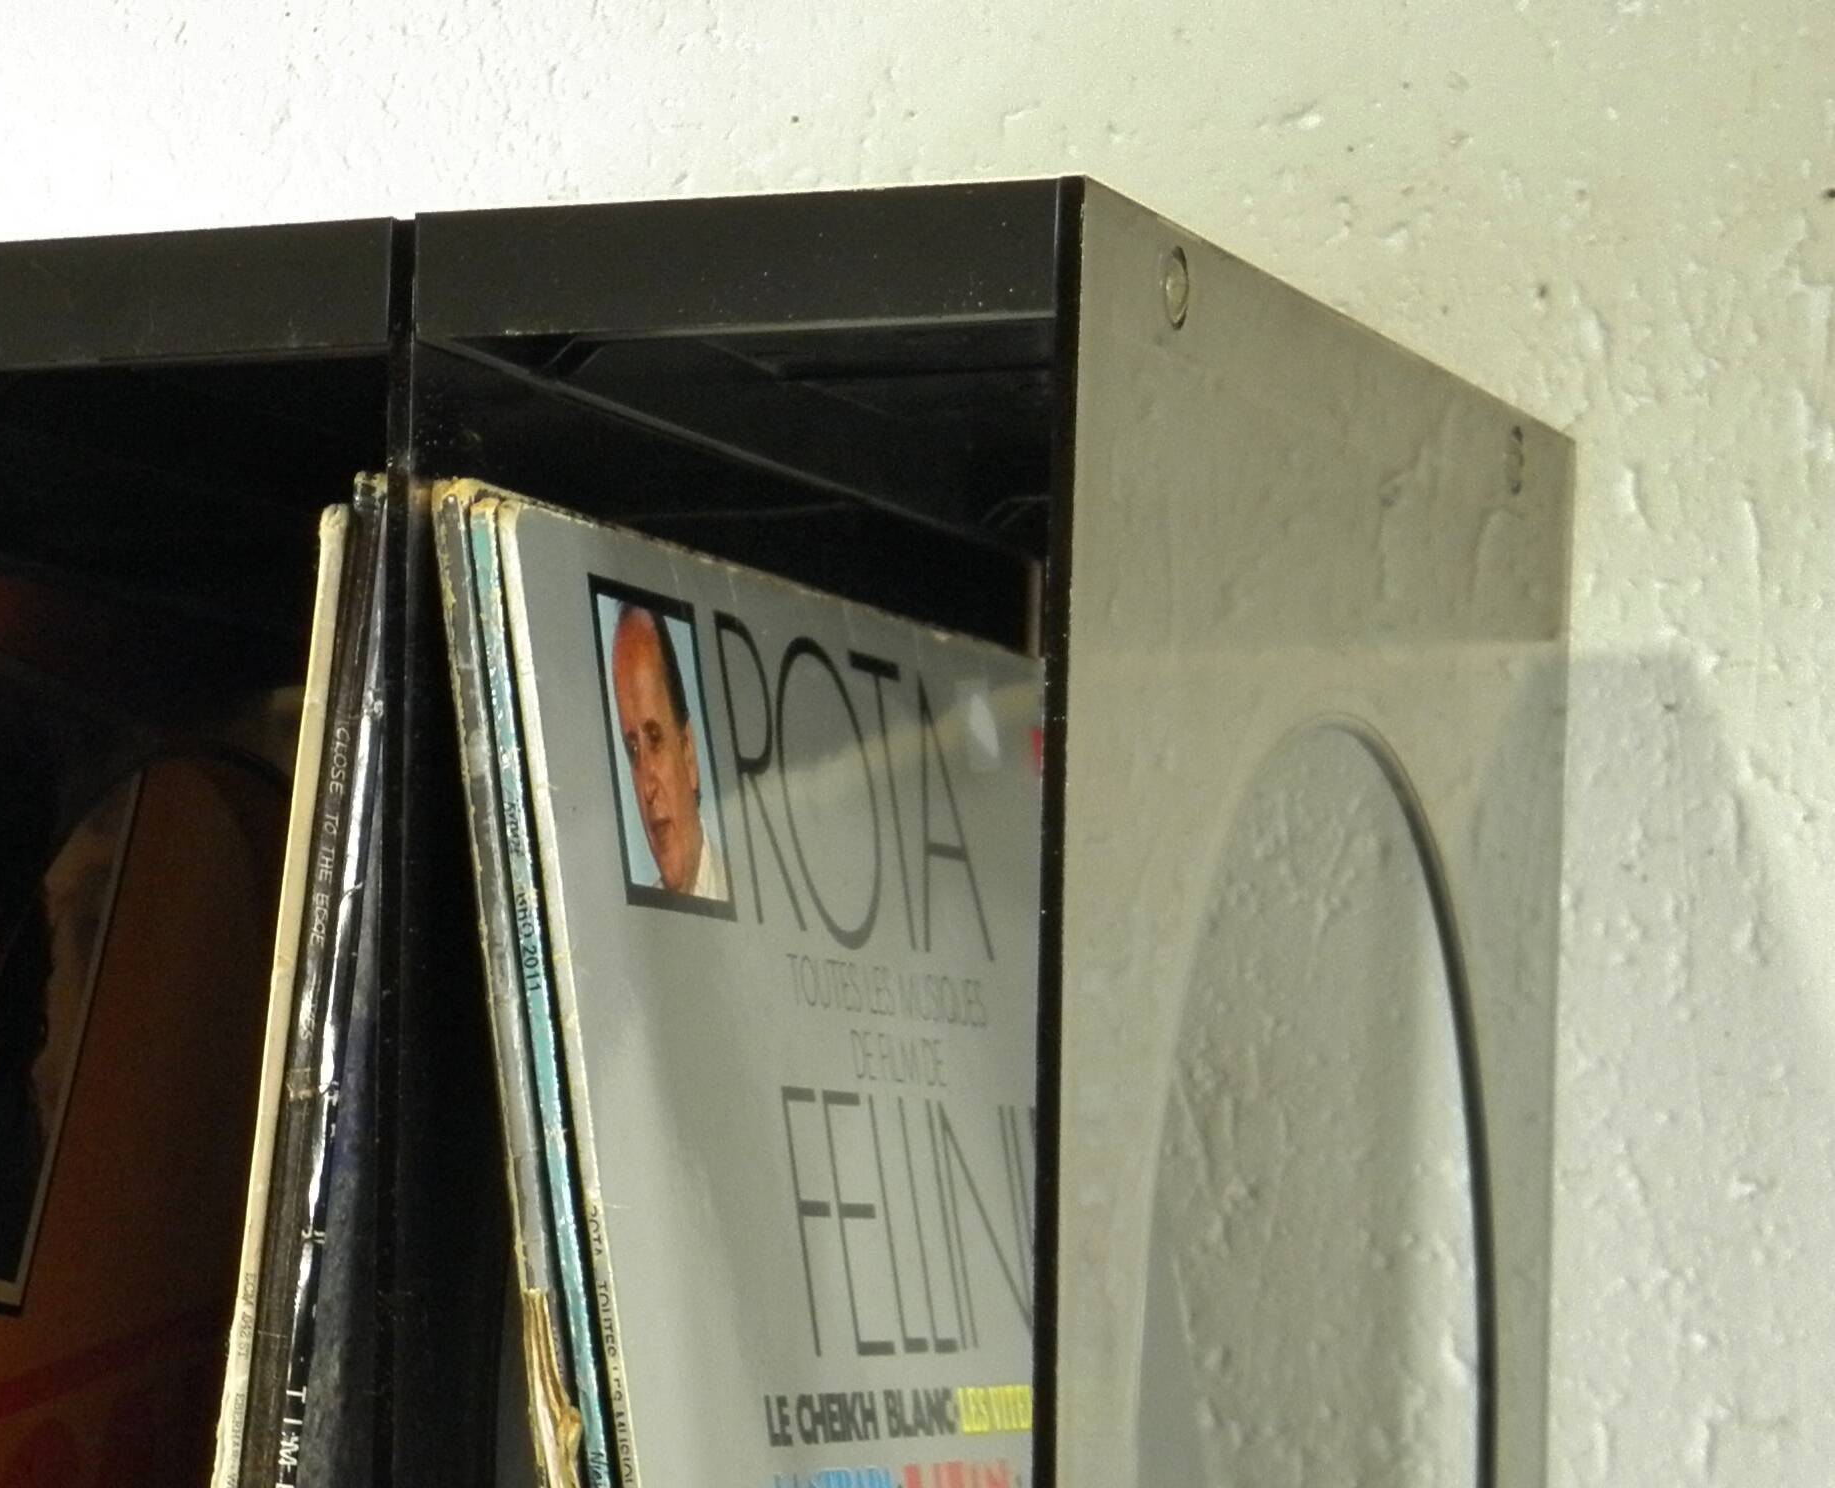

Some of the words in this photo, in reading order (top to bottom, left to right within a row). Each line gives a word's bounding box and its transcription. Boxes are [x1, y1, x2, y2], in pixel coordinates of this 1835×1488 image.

[329, 725, 350, 796] CLOSE
[713, 611, 995, 962] ROTA
[323, 812, 339, 836] TO
[317, 843, 336, 886] THE
[522, 946, 543, 994] 2011
[764, 1394, 794, 1447] LE
[796, 1389, 880, 1445] CHEIKH
[883, 1386, 958, 1438] BLANC
